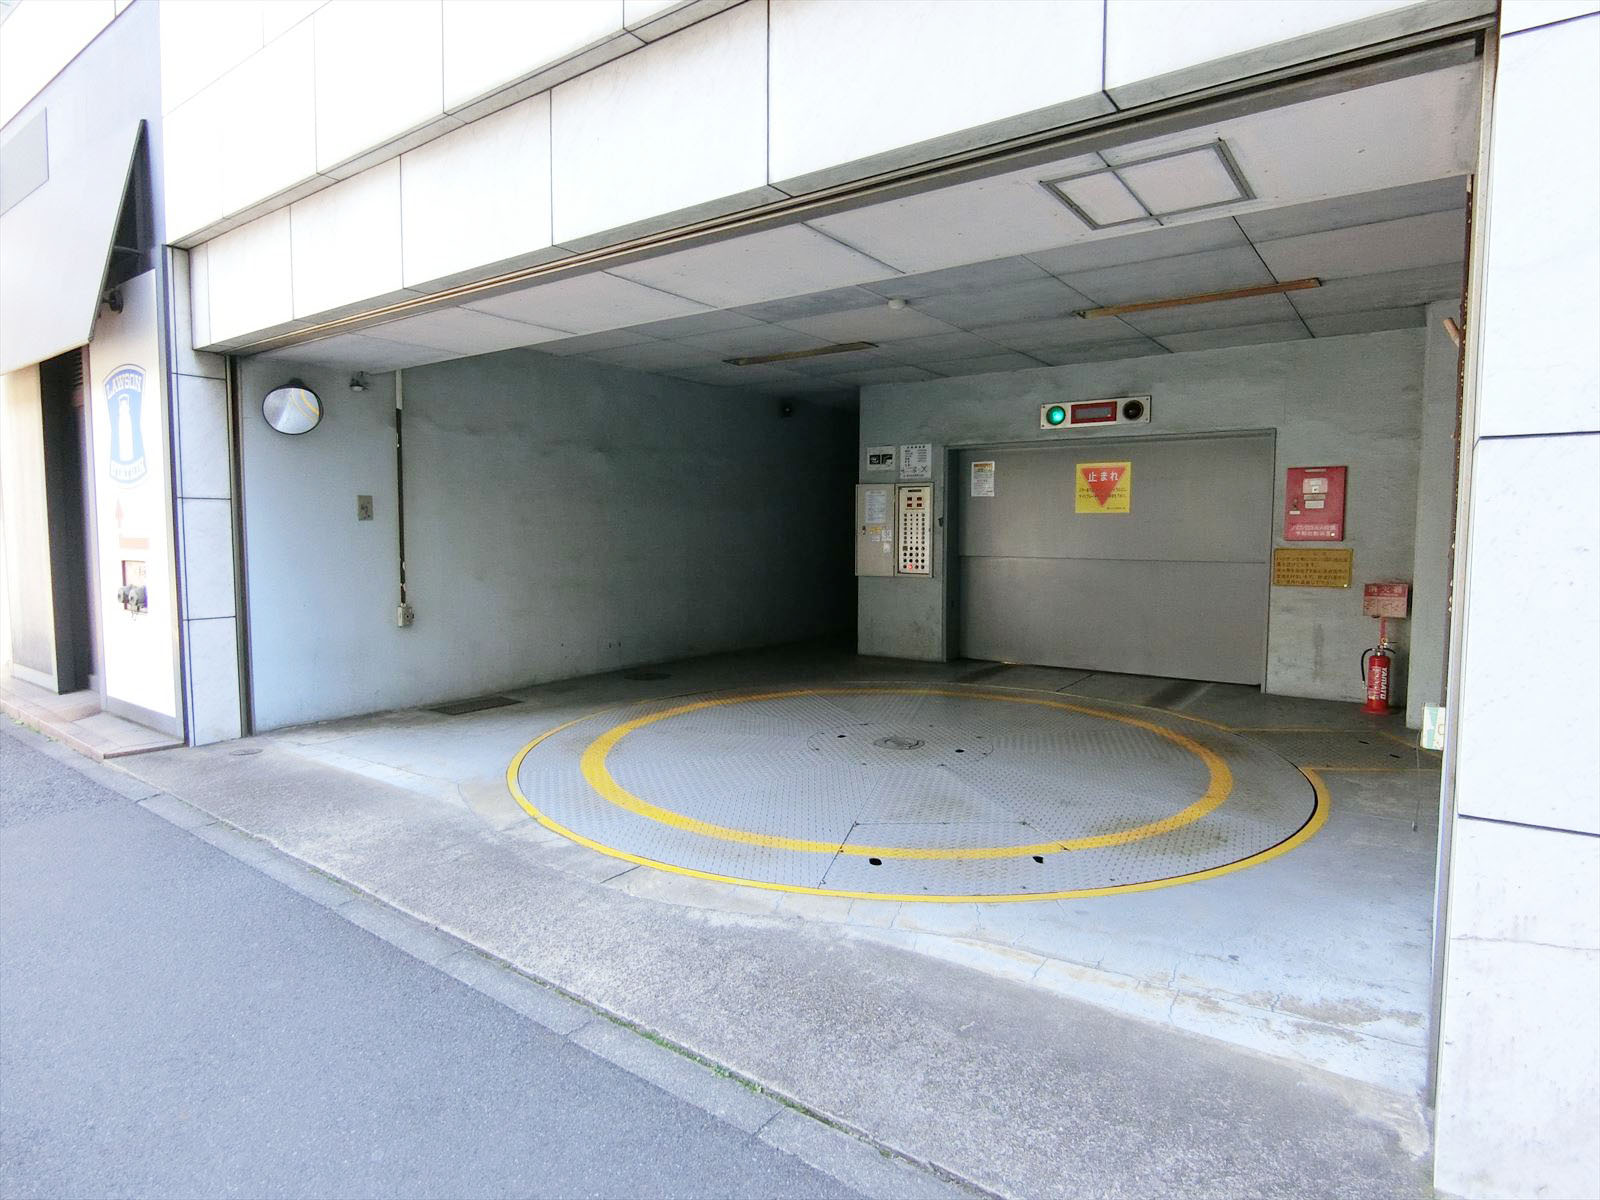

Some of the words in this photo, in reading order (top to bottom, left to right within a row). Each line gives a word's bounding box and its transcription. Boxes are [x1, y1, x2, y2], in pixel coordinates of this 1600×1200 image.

[105, 372, 143, 400] LAWSON
[1088, 471, 1119, 483] 止まれ
[1380, 667, 1388, 700] YAMATO
